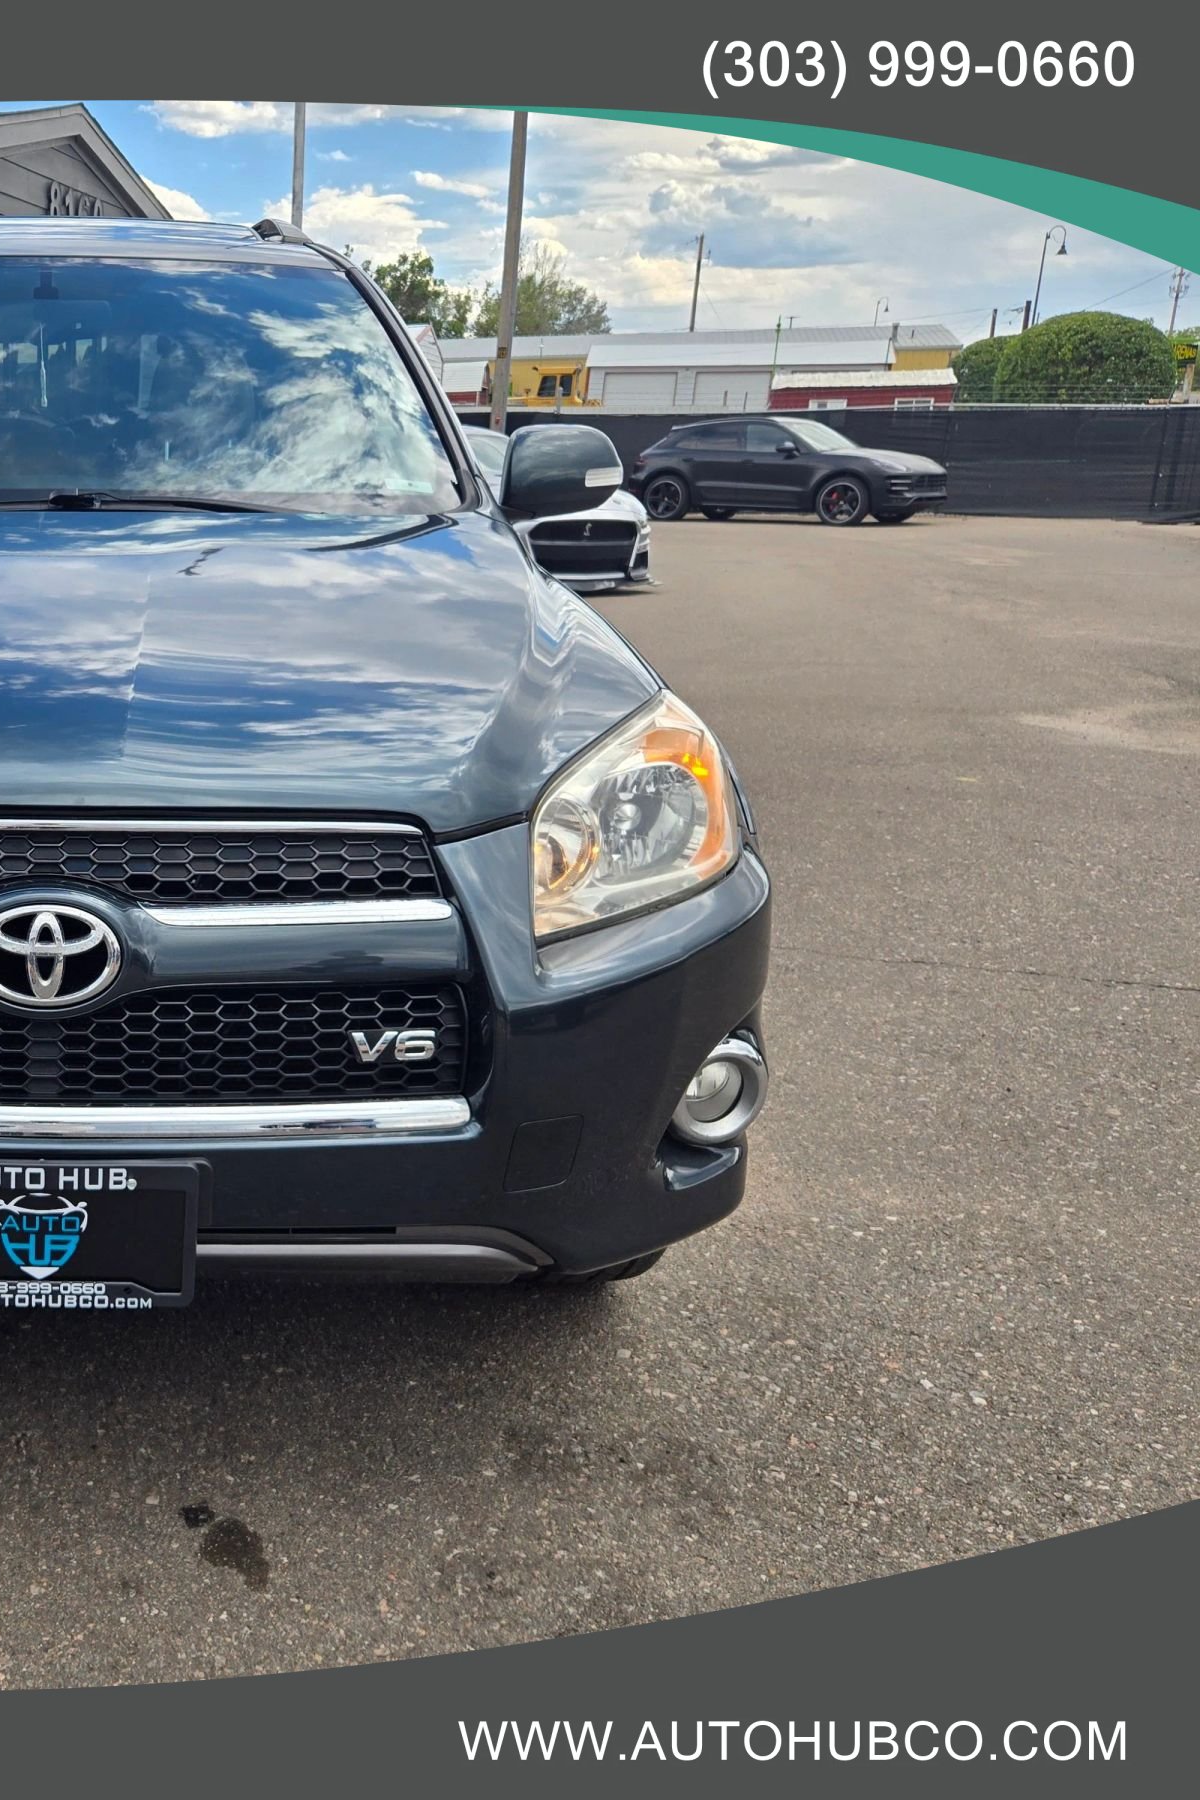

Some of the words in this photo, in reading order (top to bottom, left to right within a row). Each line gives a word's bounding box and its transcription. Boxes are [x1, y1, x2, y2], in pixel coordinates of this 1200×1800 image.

[351, 1030, 437, 1063] V6
[58, 1167, 127, 1191] HUB
[1, 1215, 80, 1232] AUTO
[1, 1233, 80, 1267] HUB
